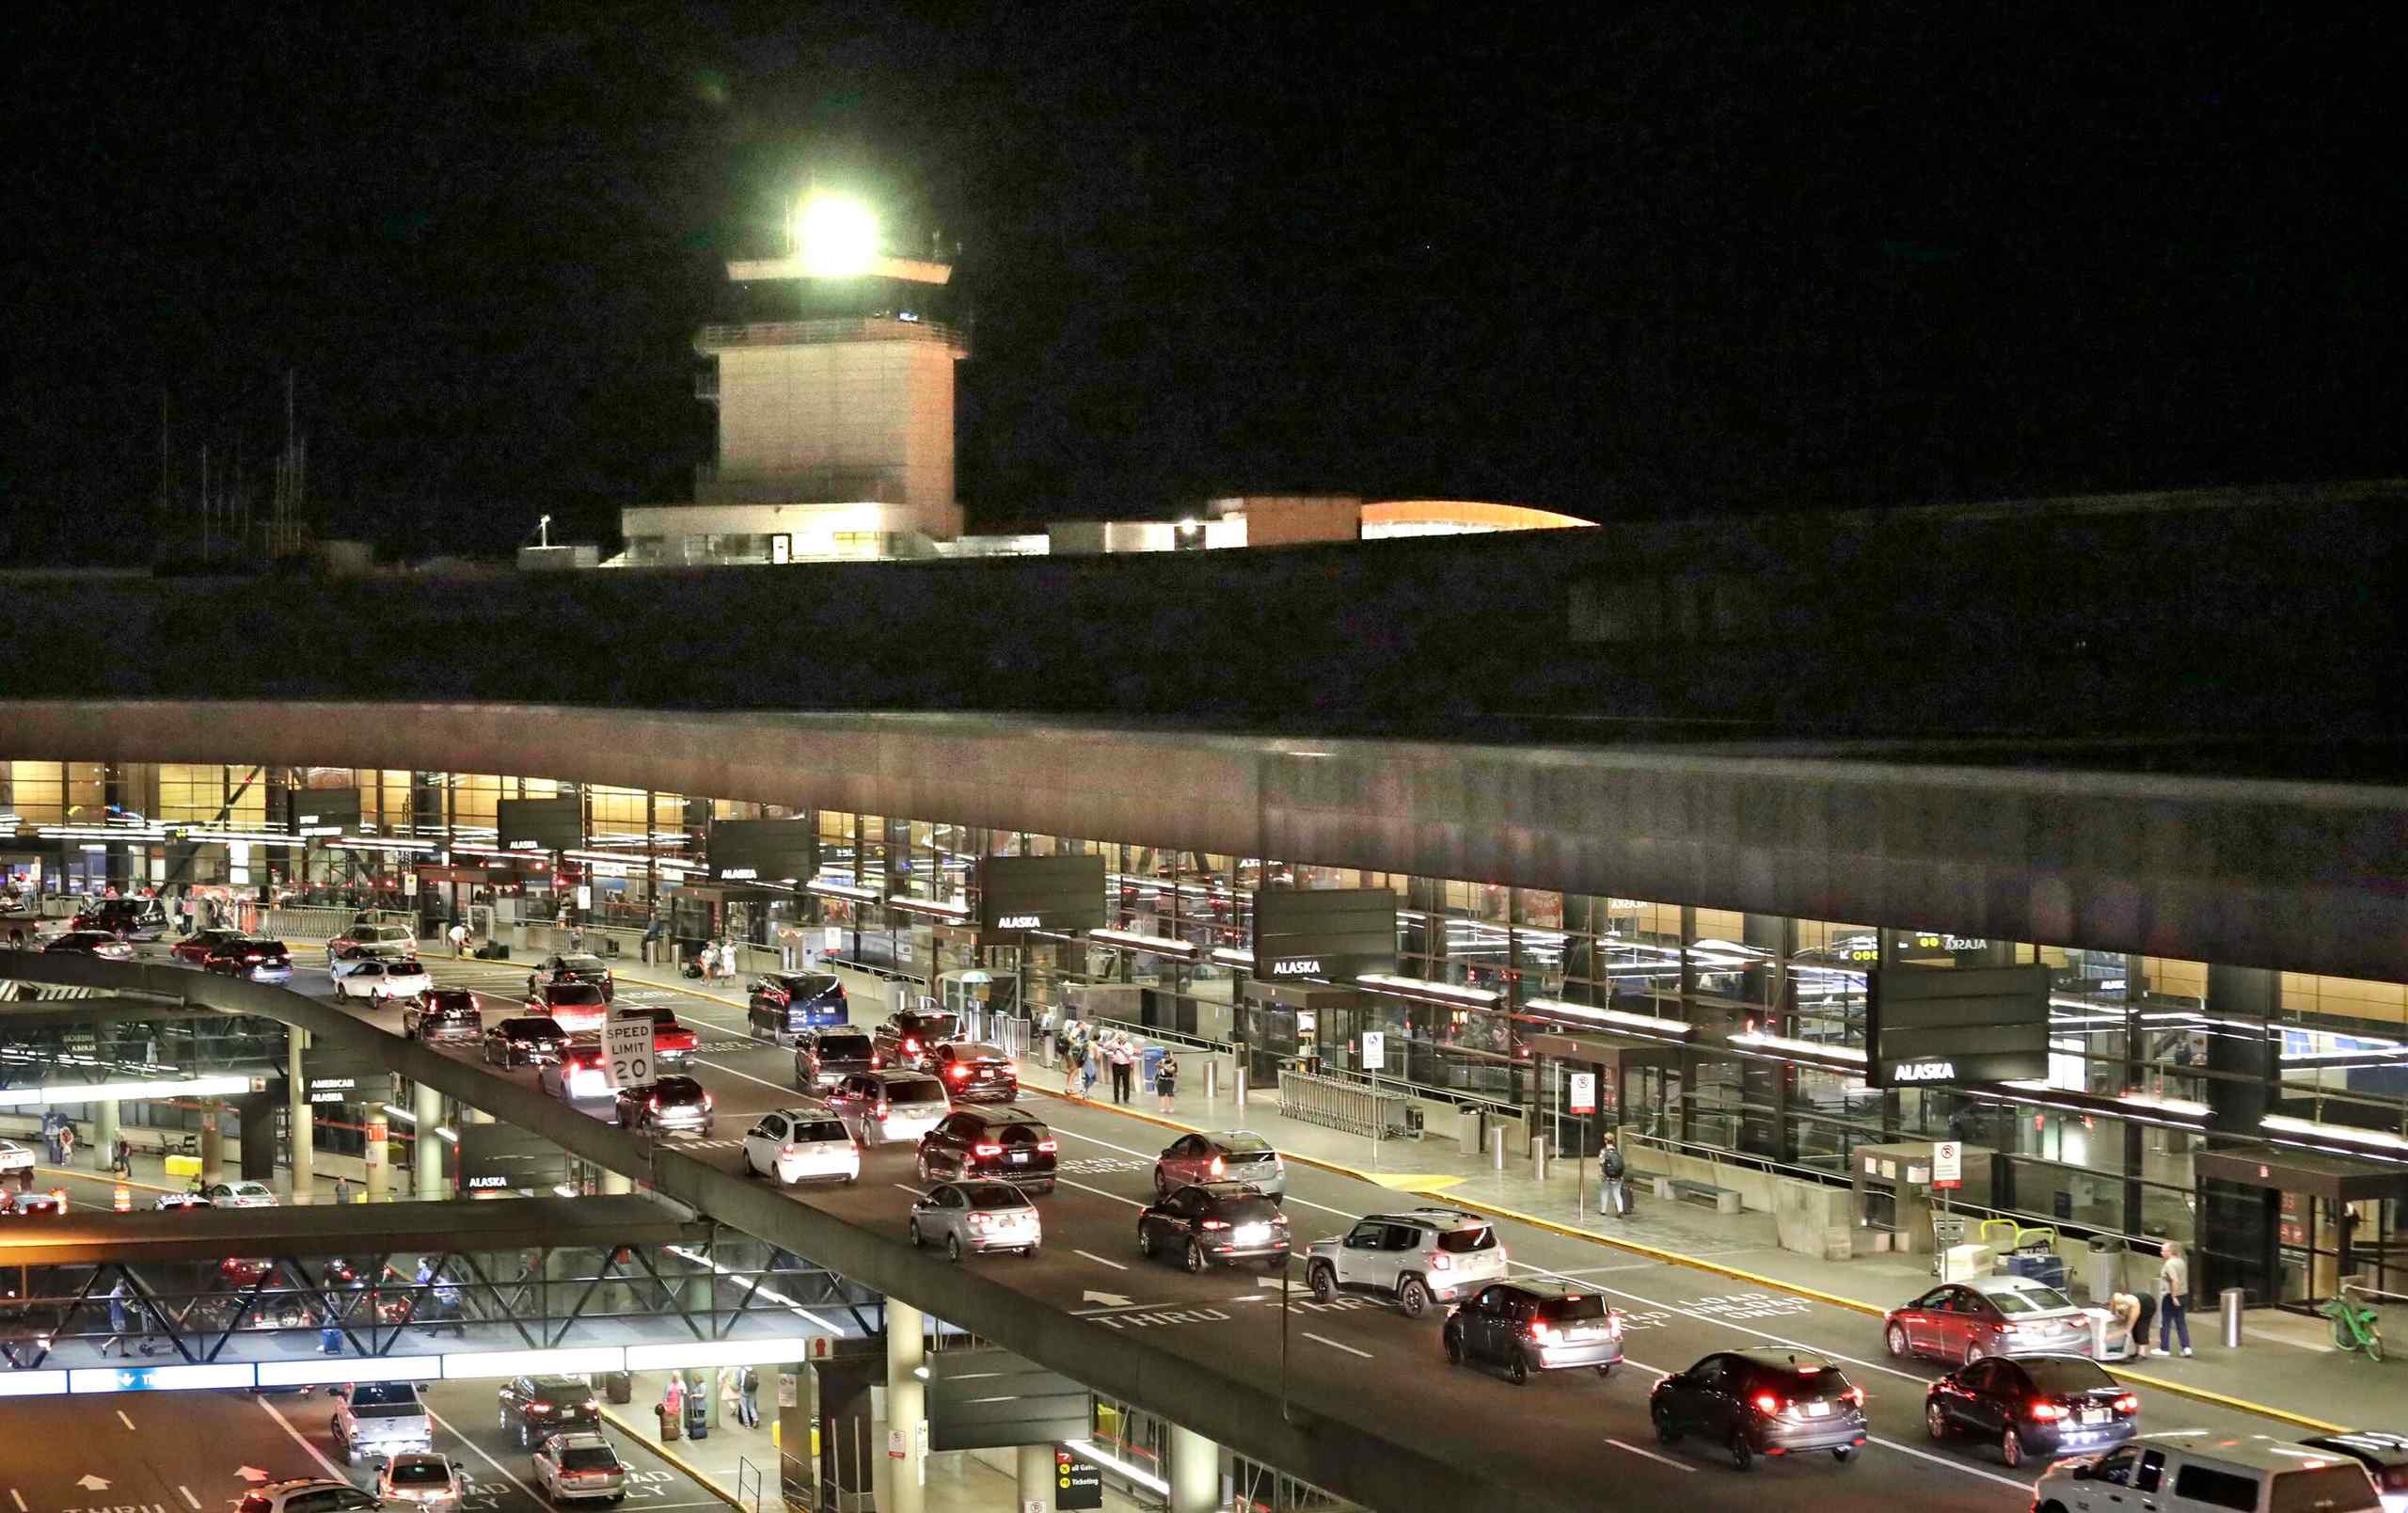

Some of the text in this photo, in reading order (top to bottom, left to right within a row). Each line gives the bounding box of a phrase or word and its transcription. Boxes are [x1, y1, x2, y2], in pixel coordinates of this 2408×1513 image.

[998, 916, 1040, 929] ALASKA
[1273, 961, 1321, 974] ALASKA
[607, 1027, 649, 1039] SPEED
[612, 1042, 645, 1055] LIMIT
[613, 1059, 647, 1079] 20
[1894, 1062, 1956, 1081] ALASKA
[311, 1078, 355, 1089] AMERICAN
[311, 1091, 344, 1102] ALASKA
[468, 1176, 507, 1187] ALASKA
[1678, 1293, 1768, 1306] LOAD
[1085, 1308, 1231, 1329] THRU
[1724, 1305, 1812, 1319] ONLY
